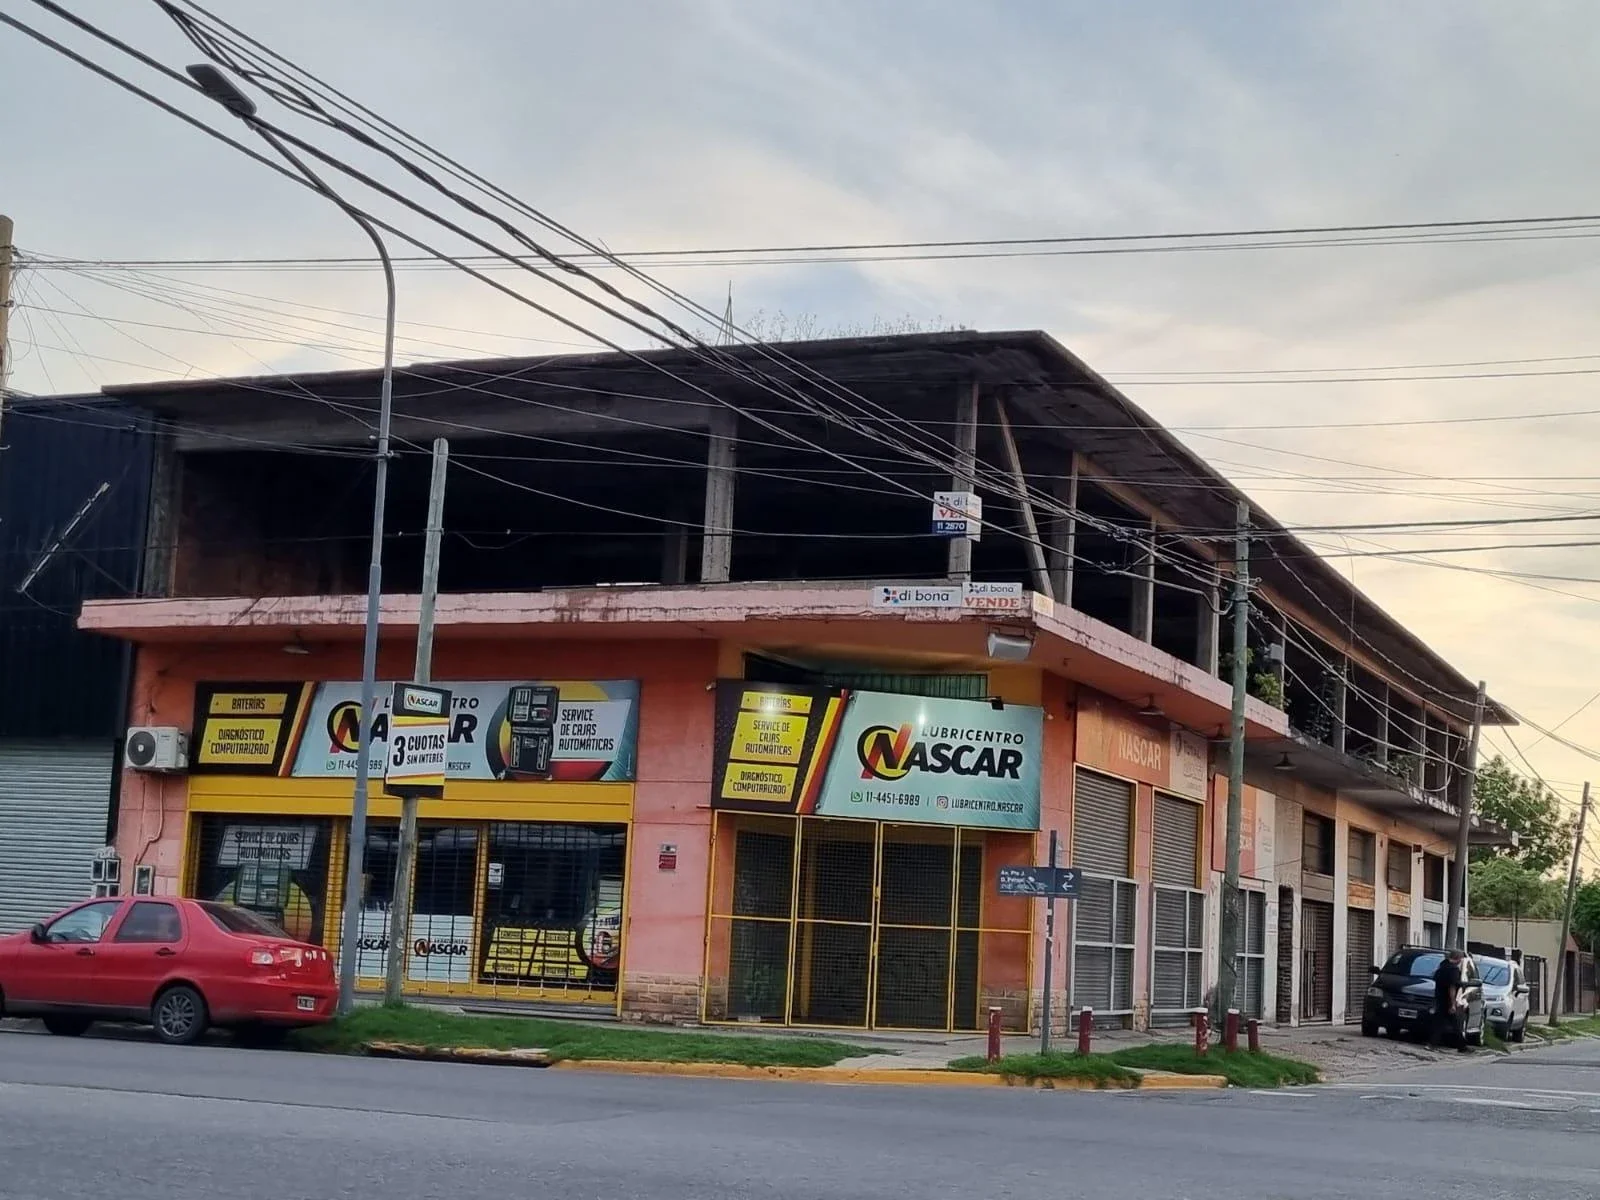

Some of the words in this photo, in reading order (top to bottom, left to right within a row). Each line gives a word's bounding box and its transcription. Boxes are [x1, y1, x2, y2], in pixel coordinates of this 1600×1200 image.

[980, 584, 989, 593] di
[990, 584, 1014, 593] bona
[899, 590, 911, 601] di
[915, 590, 949, 602] bona
[964, 597, 1020, 608] VENDE
[408, 694, 438, 708] NASCAR
[562, 708, 594, 722] SERVICE
[560, 723, 571, 735] DE
[572, 723, 597, 736] CAJAS
[753, 719, 780, 732] SERVICE
[781, 721, 791, 733] DE
[759, 732, 781, 744] CAJAS
[921, 725, 1025, 745] LUBRICENTRO
[210, 742, 269, 755] COMPUTARIZADO
[393, 735, 405, 767] 3
[407, 733, 445, 751] CUOTAS
[857, 723, 1024, 781] NASCAR
[1118, 731, 1162, 771] NASCAR
[406, 754, 417, 765] SIN
[732, 781, 787, 795] COMPUTARIZADO
[866, 791, 920, 806] 11-4451-6989
[414, 938, 468, 957] NASCAR
